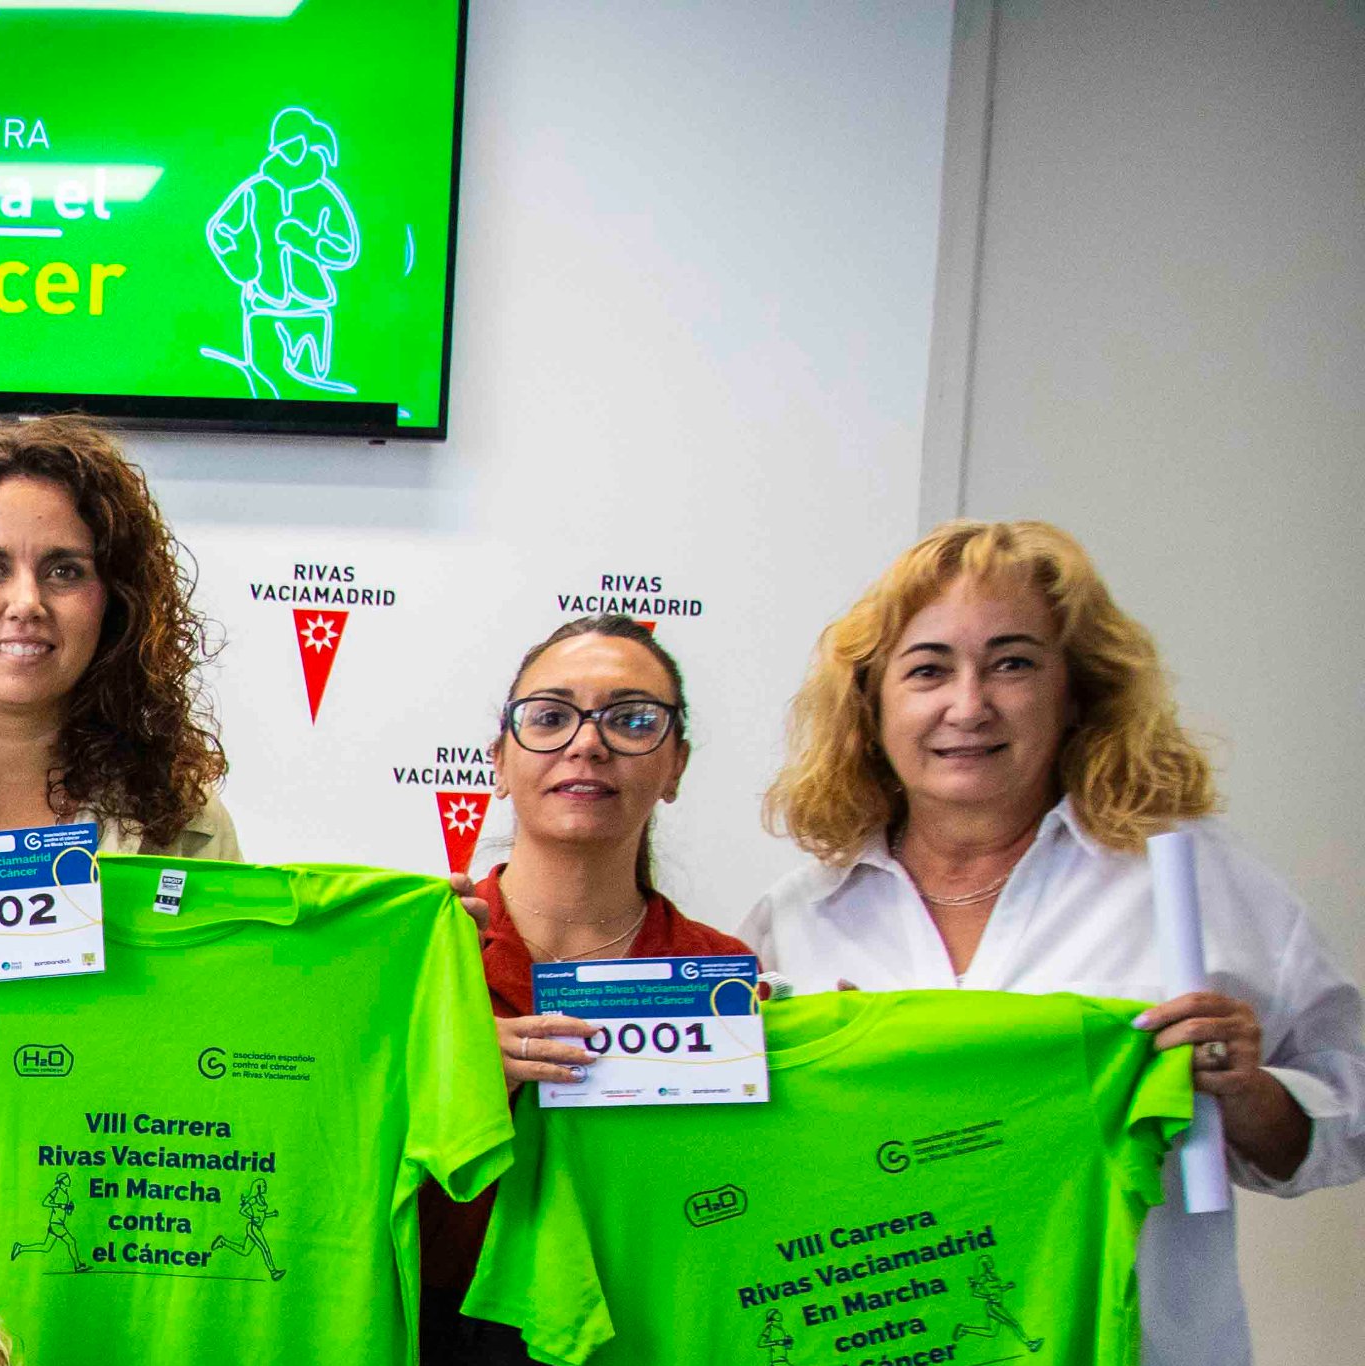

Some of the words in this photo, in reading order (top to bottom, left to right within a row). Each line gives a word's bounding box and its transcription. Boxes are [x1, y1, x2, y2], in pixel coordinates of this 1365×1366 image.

[53, 167, 111, 220] el
[294, 564, 355, 583] RIVAS
[600, 574, 663, 593] RIVAS
[250, 583, 396, 607] VACIAMADRID
[558, 594, 703, 617] VACIAMADRID
[560, 987, 603, 996] Carrera
[606, 985, 636, 994] Rivas
[638, 983, 709, 993] Vaciamadrid
[540, 1000, 555, 1010] En
[557, 998, 599, 1008] Marcha
[602, 998, 639, 1006] contra
[584, 1022, 712, 1055] 0001
[23, 1051, 64, 1066] H2O
[85, 1112, 127, 1133] VIII
[133, 1114, 231, 1138] Carrera
[38, 1146, 106, 1166] Rivas
[112, 1146, 276, 1173] Vaciamadrid
[89, 1178, 118, 1199] En
[127, 1178, 221, 1202] Marcha
[108, 1211, 191, 1233] contra
[776, 1234, 825, 1262] VIII
[830, 1210, 937, 1250] Carrera
[92, 1242, 116, 1263] el
[122, 1242, 212, 1267] Cáncer
[738, 1274, 813, 1309] Rivas
[816, 1225, 997, 1288] Vaciamadrid
[802, 1302, 838, 1327] En
[842, 1276, 948, 1316] Marcha
[835, 1316, 927, 1353] contra
